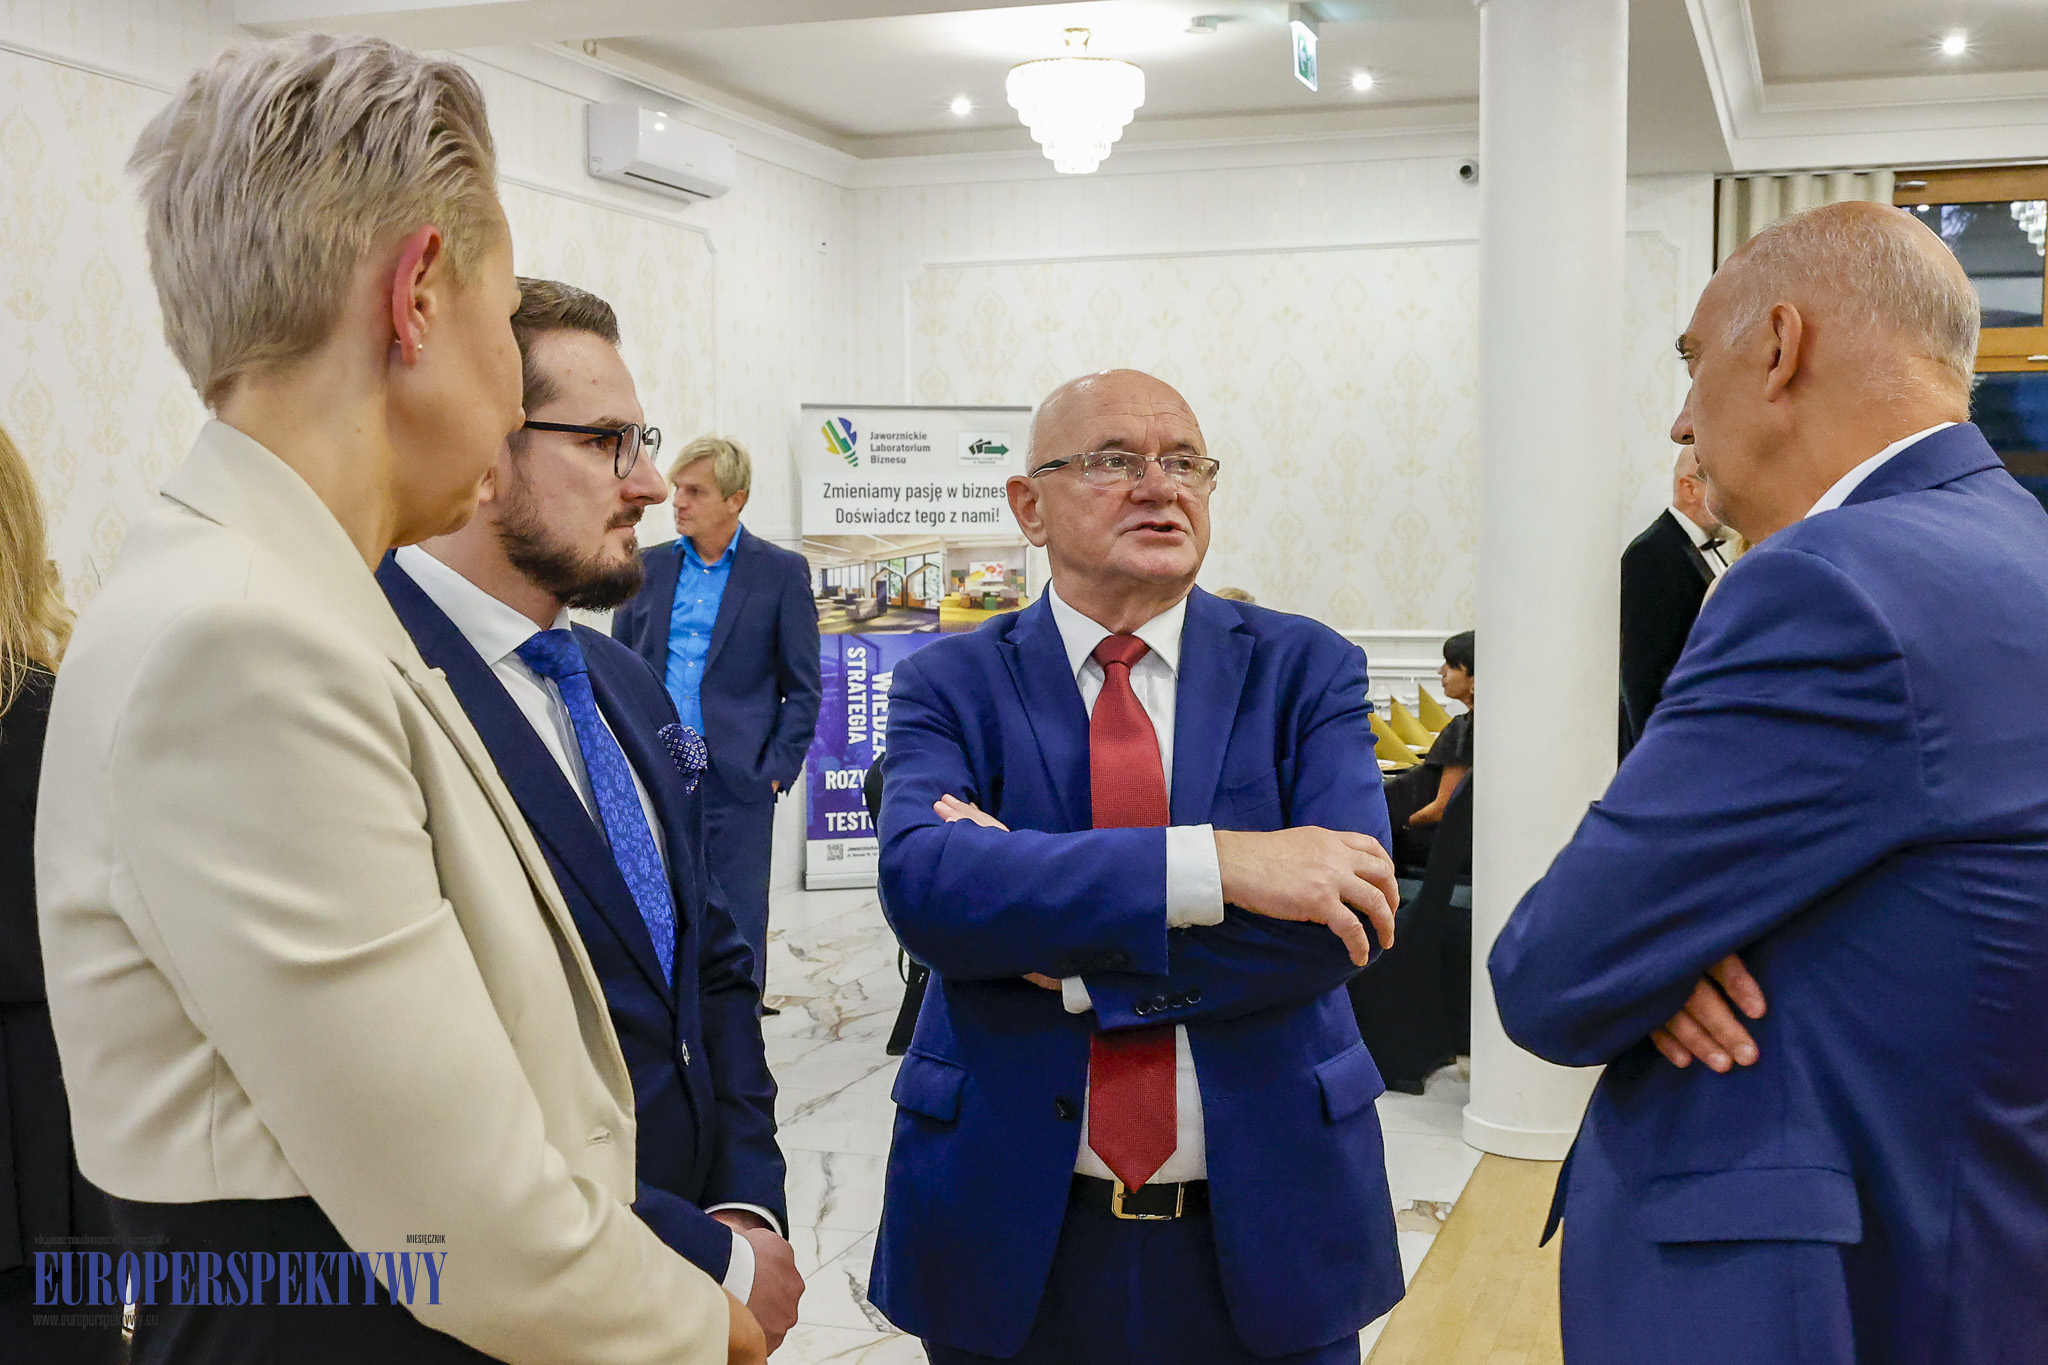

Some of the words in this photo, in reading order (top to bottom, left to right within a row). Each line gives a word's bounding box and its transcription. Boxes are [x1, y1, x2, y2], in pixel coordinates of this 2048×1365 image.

[869, 431, 928, 440] Jaworznickie
[869, 443, 931, 452] Laboratorium
[870, 454, 907, 464] Biznesu
[823, 483, 901, 501] Zmieniamy
[905, 483, 942, 502] pasję
[947, 486, 958, 498] w
[962, 483, 1006, 499] biznes
[836, 507, 911, 523] Doświadcz
[915, 509, 946, 527] tego
[950, 511, 957, 523] z
[961, 508, 1000, 523] nami!
[847, 646, 867, 745] STRATEGIA
